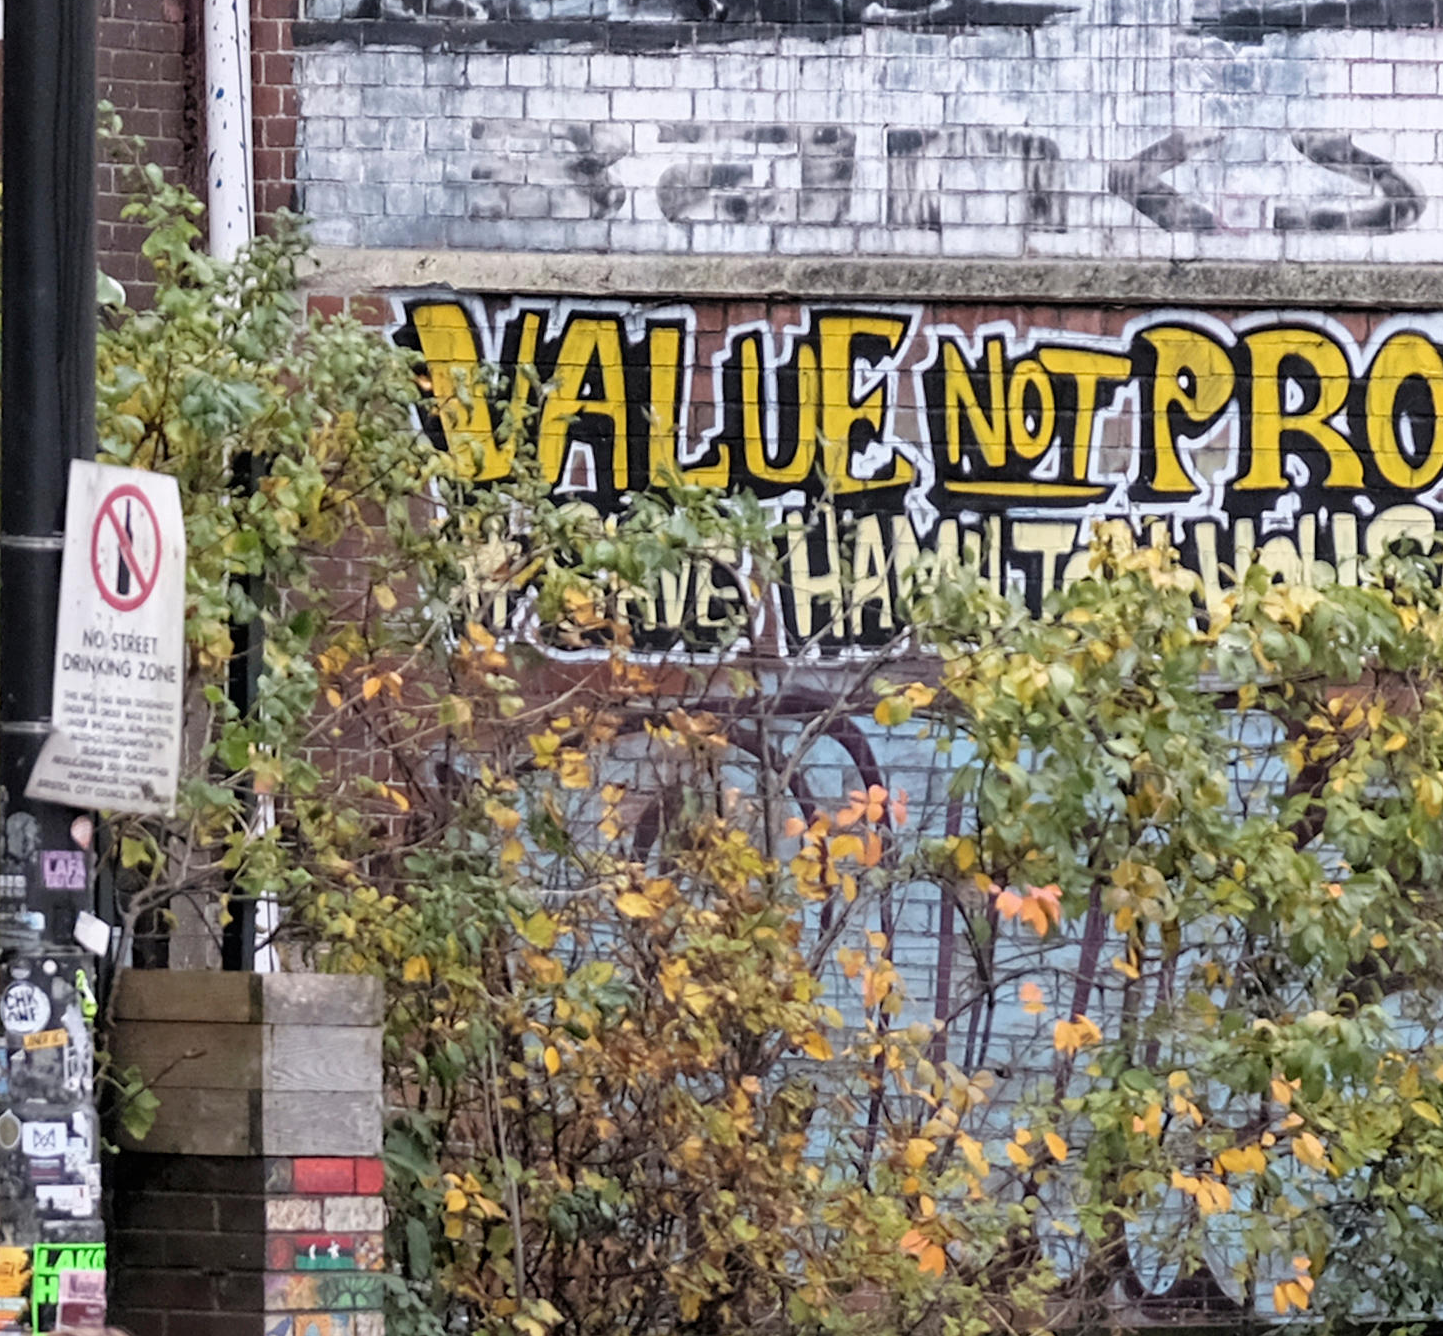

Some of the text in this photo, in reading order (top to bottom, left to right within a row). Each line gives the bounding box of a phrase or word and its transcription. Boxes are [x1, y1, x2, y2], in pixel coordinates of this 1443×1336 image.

[395, 297, 922, 497] VALUE
[943, 339, 1140, 480] NOT
[83, 629, 158, 655] NO STREET
[63, 654, 176, 683] DRINKING ZONE
